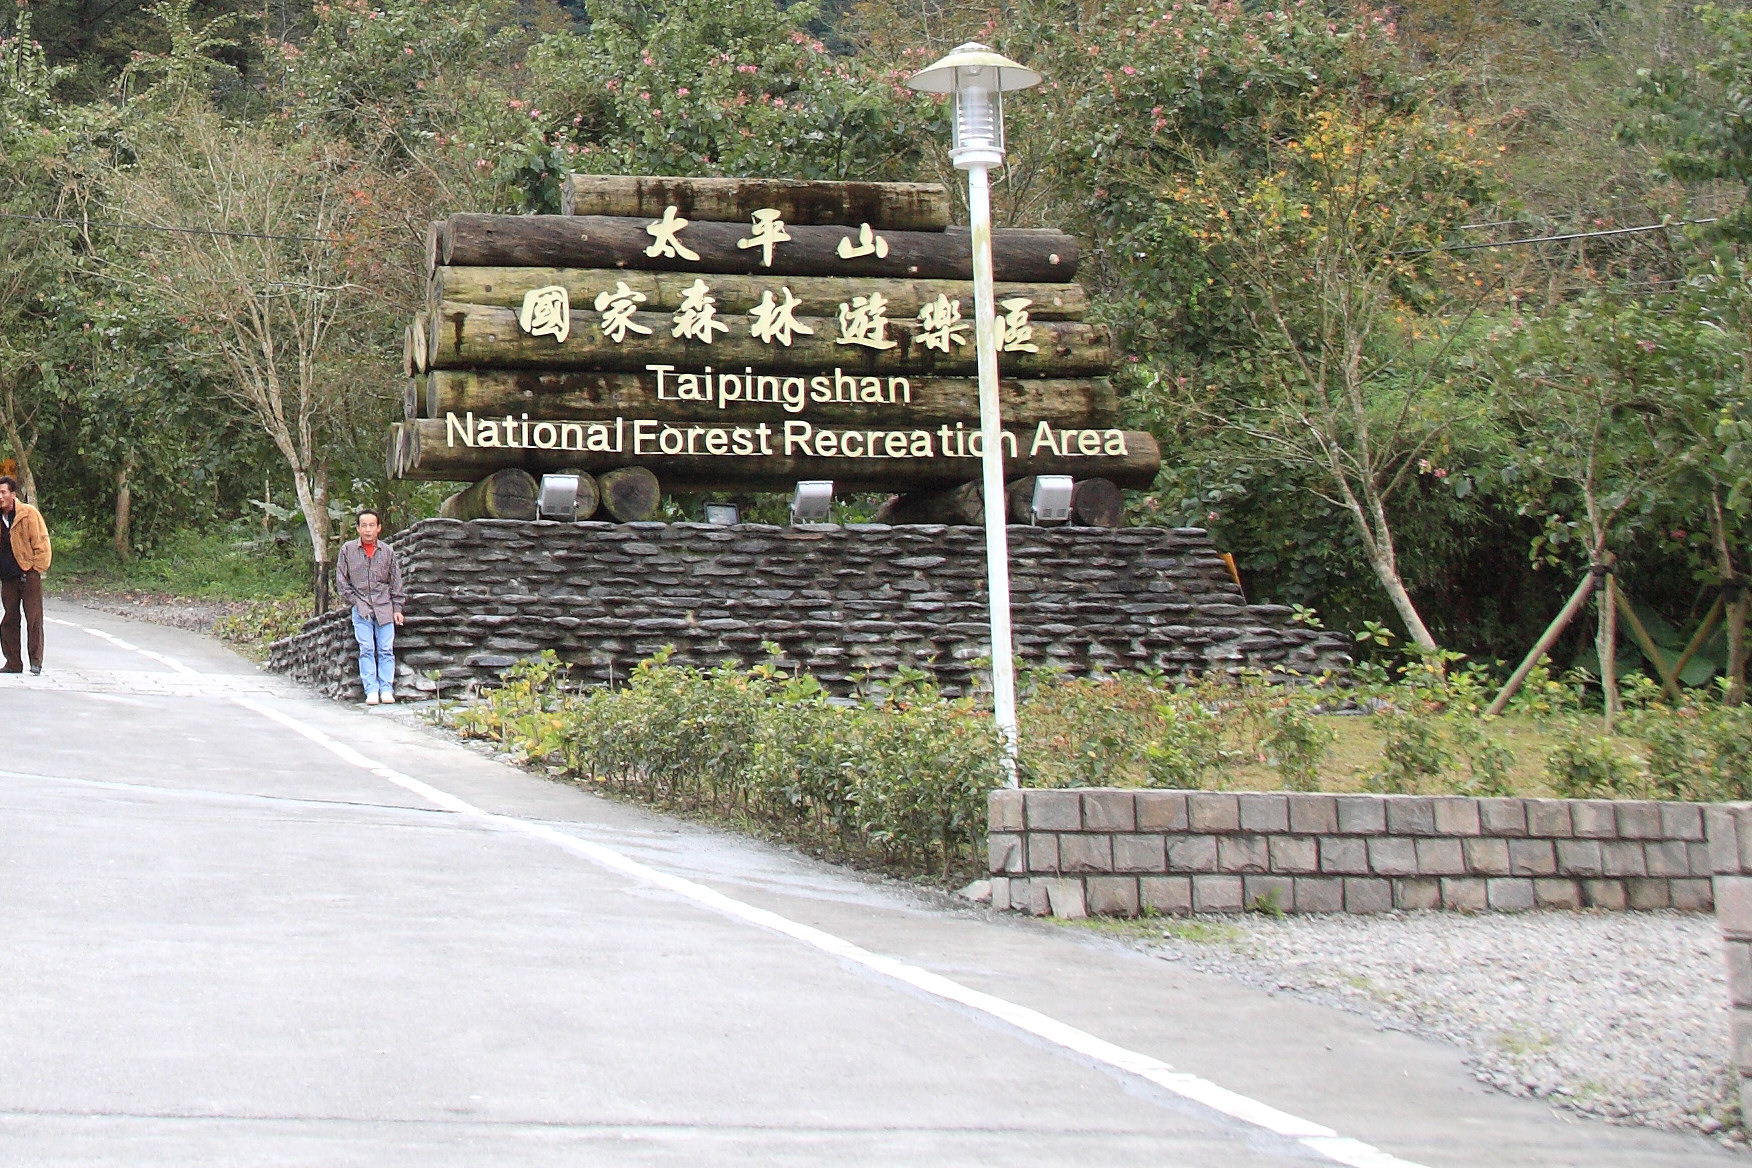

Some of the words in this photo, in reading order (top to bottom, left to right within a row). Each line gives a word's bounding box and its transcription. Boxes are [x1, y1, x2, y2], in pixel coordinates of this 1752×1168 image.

[643, 205, 889, 267] 太平山
[519, 278, 1039, 353] 國家森林遊樂區
[646, 364, 911, 412] Taipingshan
[446, 411, 623, 453] National
[633, 419, 773, 456] Forest
[783, 420, 1018, 458] Recreation
[1030, 420, 1128, 456] Area
